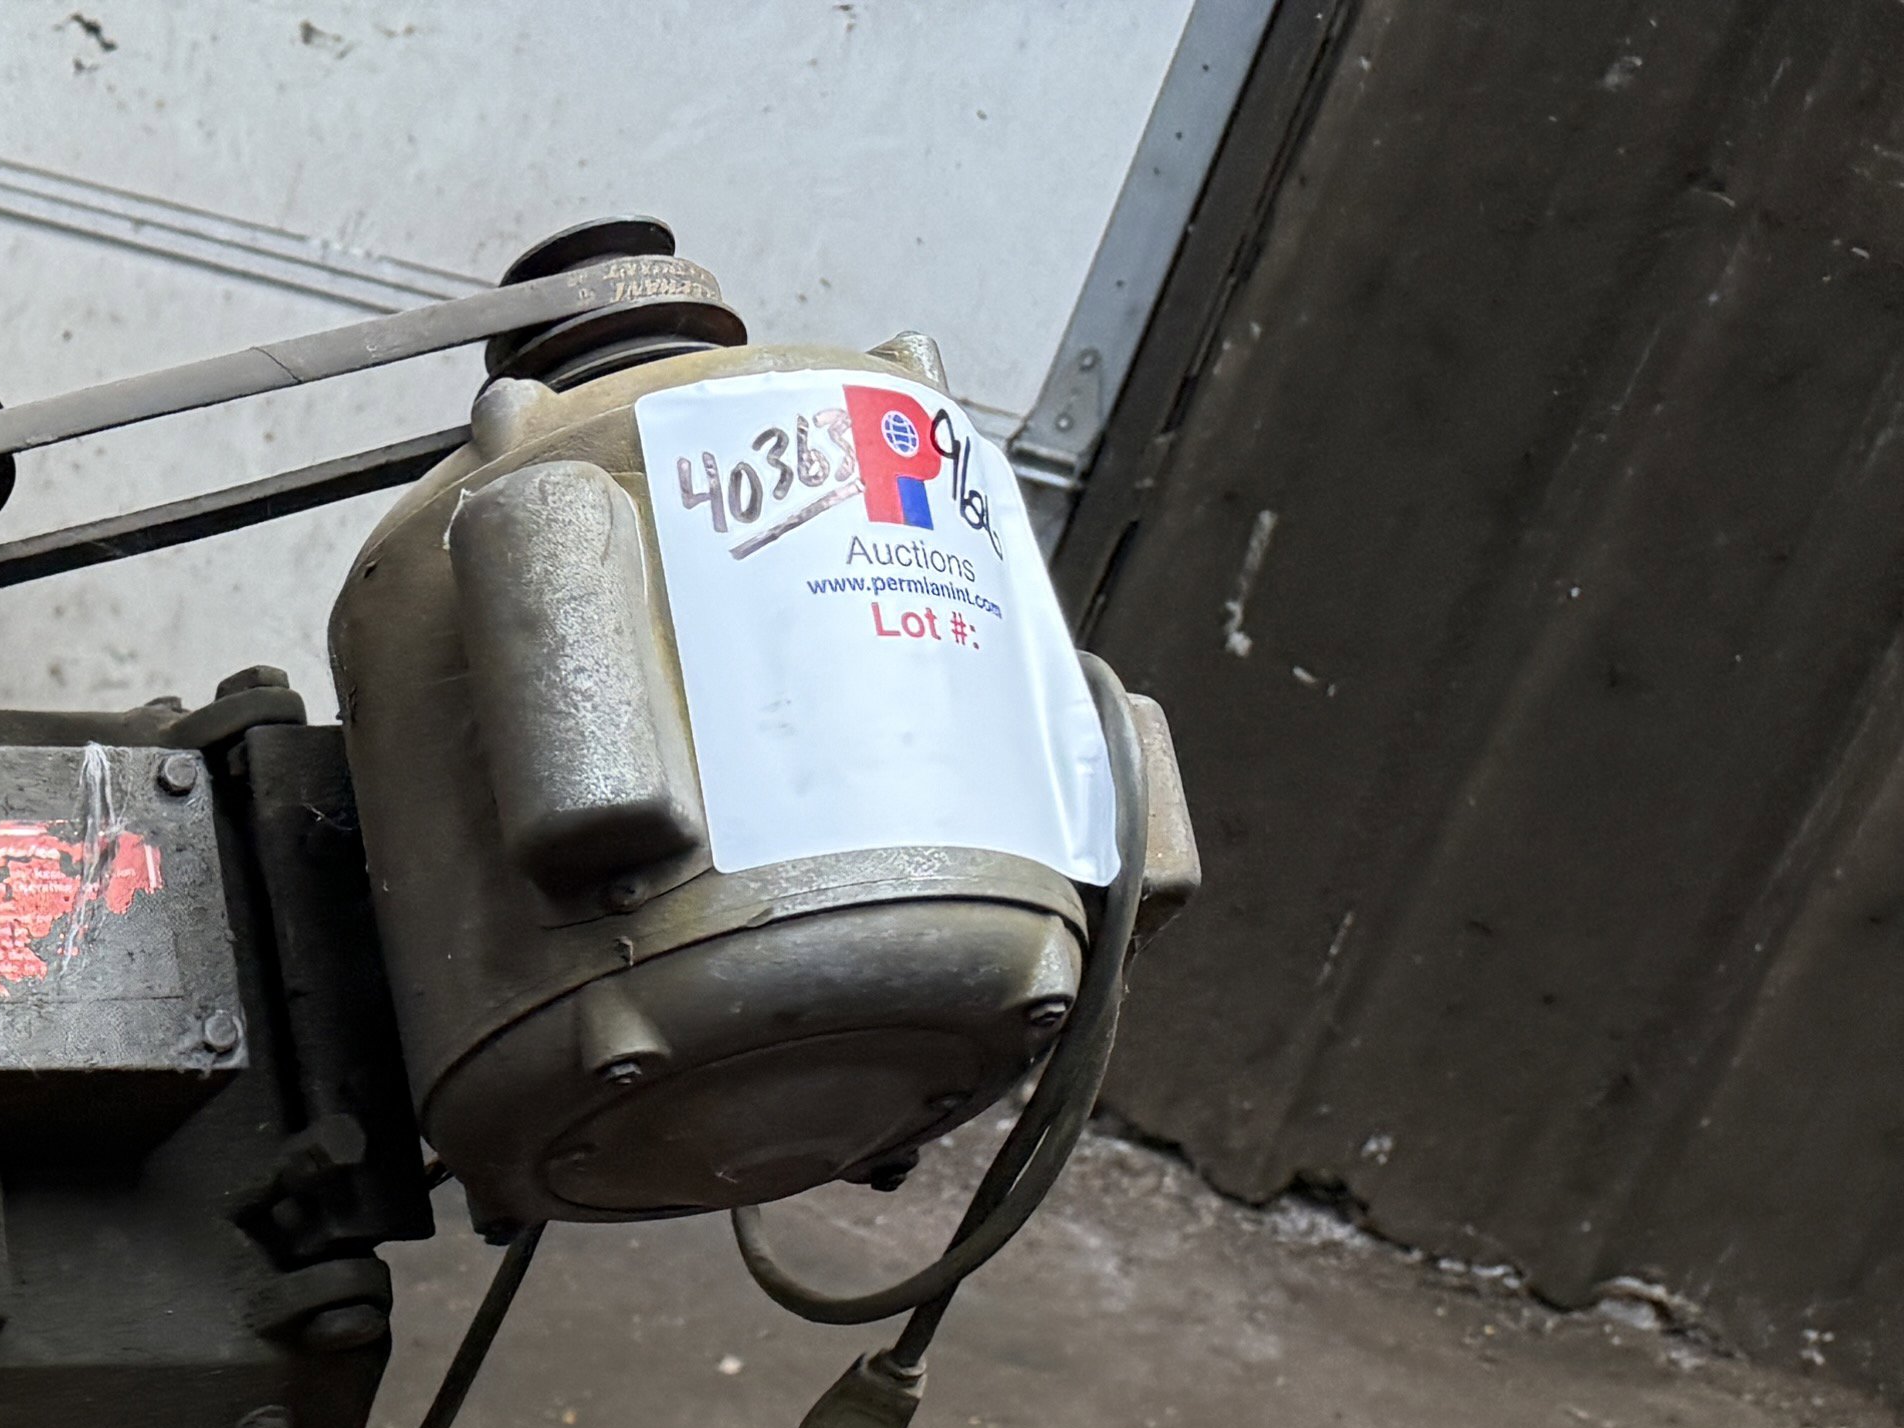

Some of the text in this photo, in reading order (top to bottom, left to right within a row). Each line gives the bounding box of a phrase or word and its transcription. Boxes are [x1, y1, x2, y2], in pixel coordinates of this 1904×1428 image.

[677, 408, 855, 533] 40363
[846, 535, 976, 583] Auctions
[871, 601, 979, 650] Lot #:
